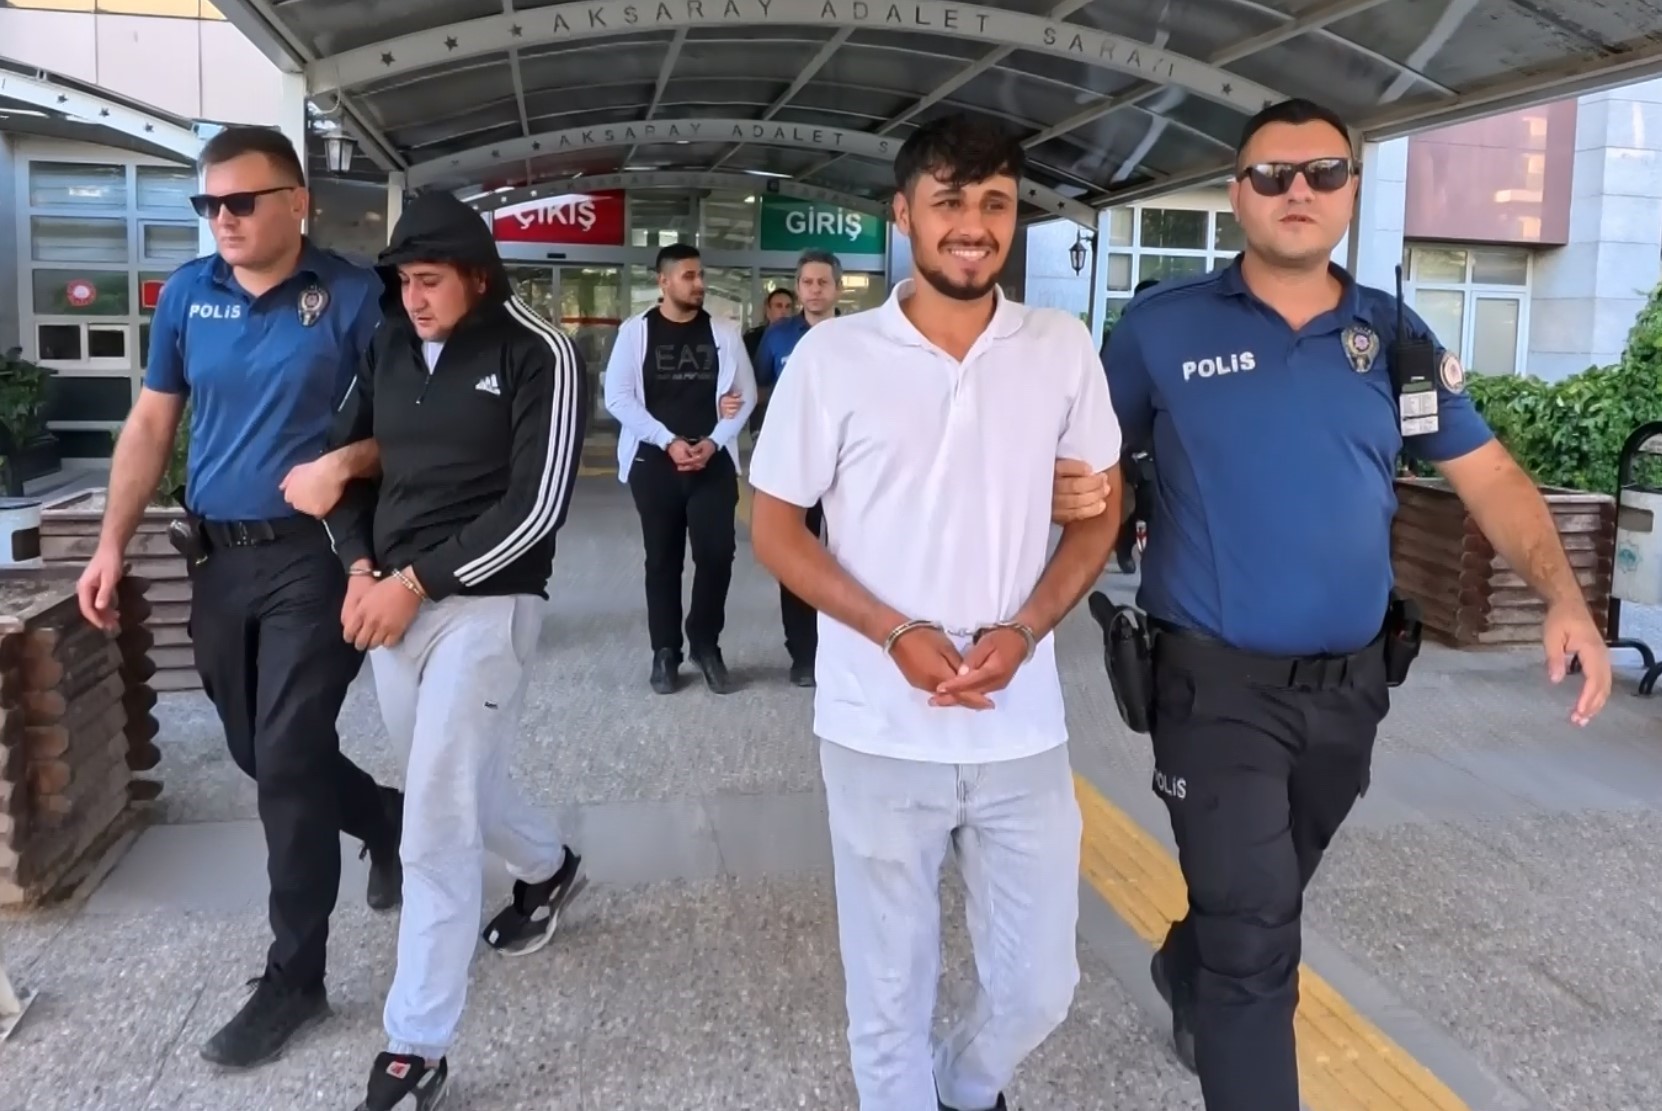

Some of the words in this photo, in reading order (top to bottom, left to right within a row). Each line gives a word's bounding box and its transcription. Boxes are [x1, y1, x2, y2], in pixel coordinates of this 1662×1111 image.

[553, 0, 771, 33] AKSARAY
[821, 0, 989, 33] ADALET
[559, 123, 701, 147] AKSARAY
[732, 124, 844, 146] ADALET
[785, 206, 862, 242] GİRİŞ
